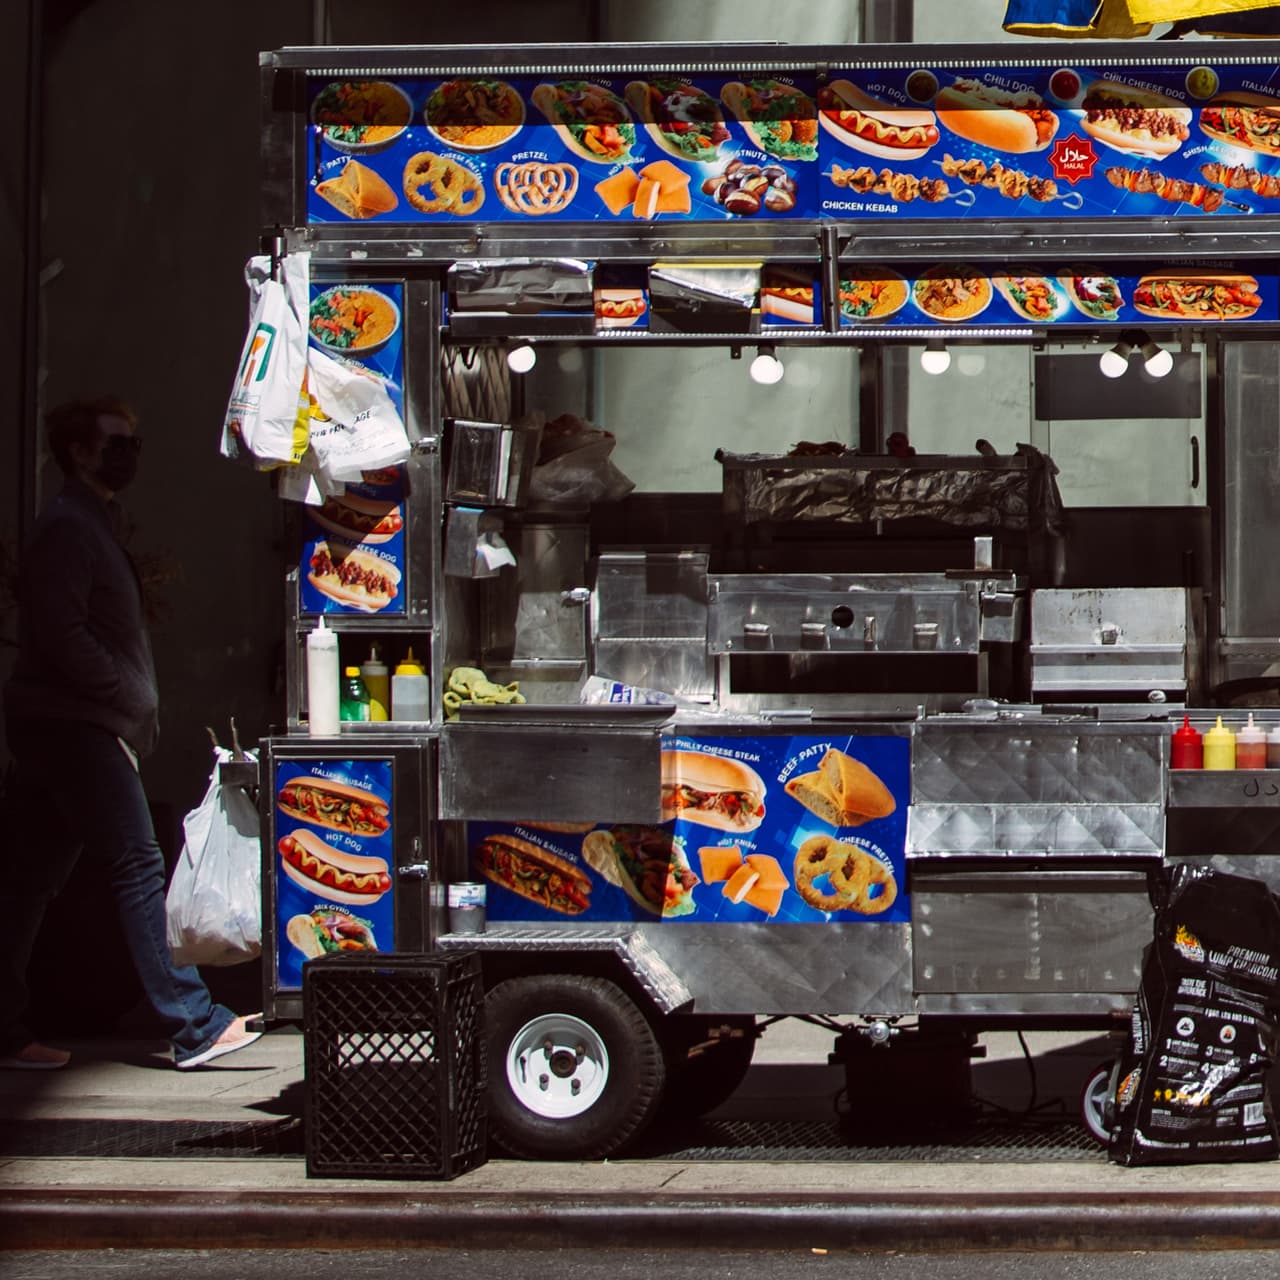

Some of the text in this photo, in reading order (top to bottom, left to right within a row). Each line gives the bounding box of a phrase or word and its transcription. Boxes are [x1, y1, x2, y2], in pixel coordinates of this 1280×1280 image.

[984, 72, 1035, 93] CHILI DOG
[1103, 71, 1186, 101] CHILI CHEESE DOG
[1241, 79, 1276, 95] ITALIAN
[867, 83, 907, 104] HOT DOG
[327, 155, 352, 170] PATTY
[512, 151, 549, 162] PRETZEL
[1059, 146, 1088, 163] حلال
[822, 200, 898, 213] CHICKEN KEBAB
[379, 550, 397, 564] DOG
[675, 738, 703, 753] PHILLY
[703, 744, 734, 758] CHEESE
[734, 749, 761, 762] STEAK
[777, 742, 832, 784] BEEF PATTY
[311, 767, 338, 782] ITALIAN
[325, 832, 362, 852] HOT DOG
[514, 825, 579, 864] ITALIAN SAUSAGE
[839, 836, 895, 875] CHEESE PRETZEL
[329, 904, 350, 916] GYRO
[1227, 944, 1270, 964] PREMIUM
[1208, 950, 1233, 967] LUMP
[1233, 959, 1279, 981] CHRCOAL
[1166, 1038, 1172, 1049] 1
[1205, 1045, 1214, 1056] 3
[1159, 1055, 1169, 1066] 2
